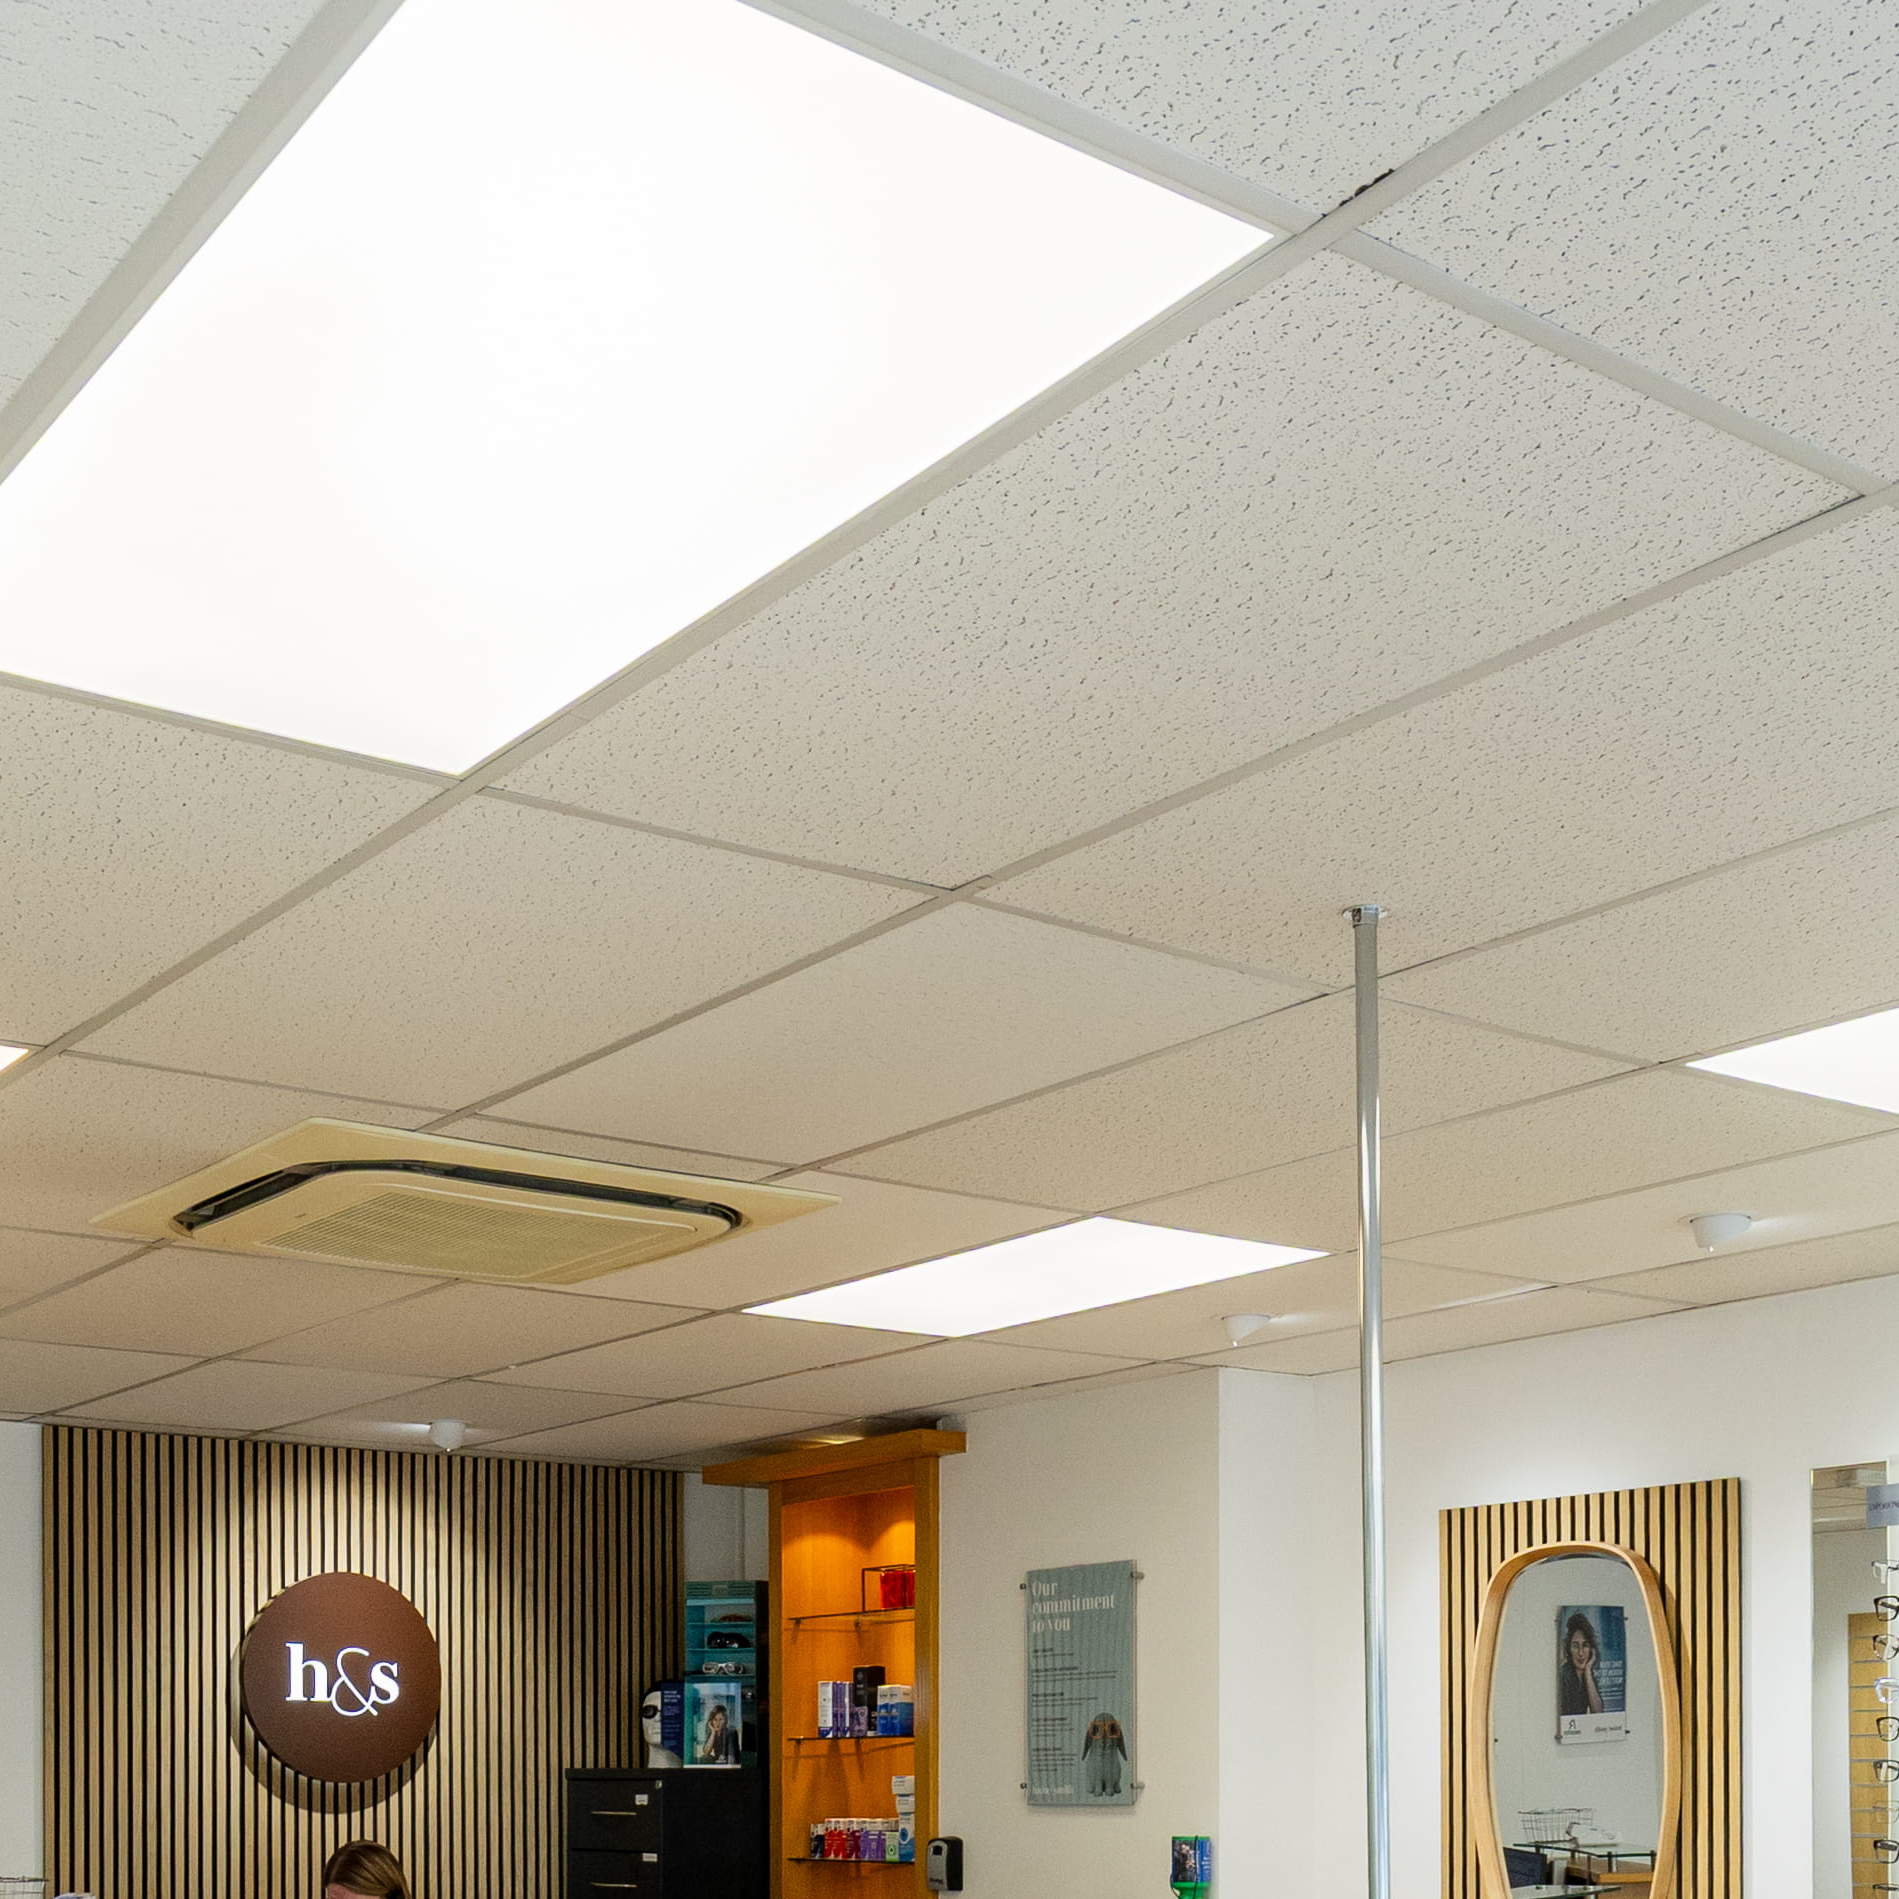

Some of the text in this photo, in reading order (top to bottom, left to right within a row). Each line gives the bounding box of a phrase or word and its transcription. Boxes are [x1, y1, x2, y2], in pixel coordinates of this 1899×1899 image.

[1032, 1580, 1058, 1597] Our
[1032, 1594, 1115, 1614] commitment
[285, 1642, 400, 1717] h&s
